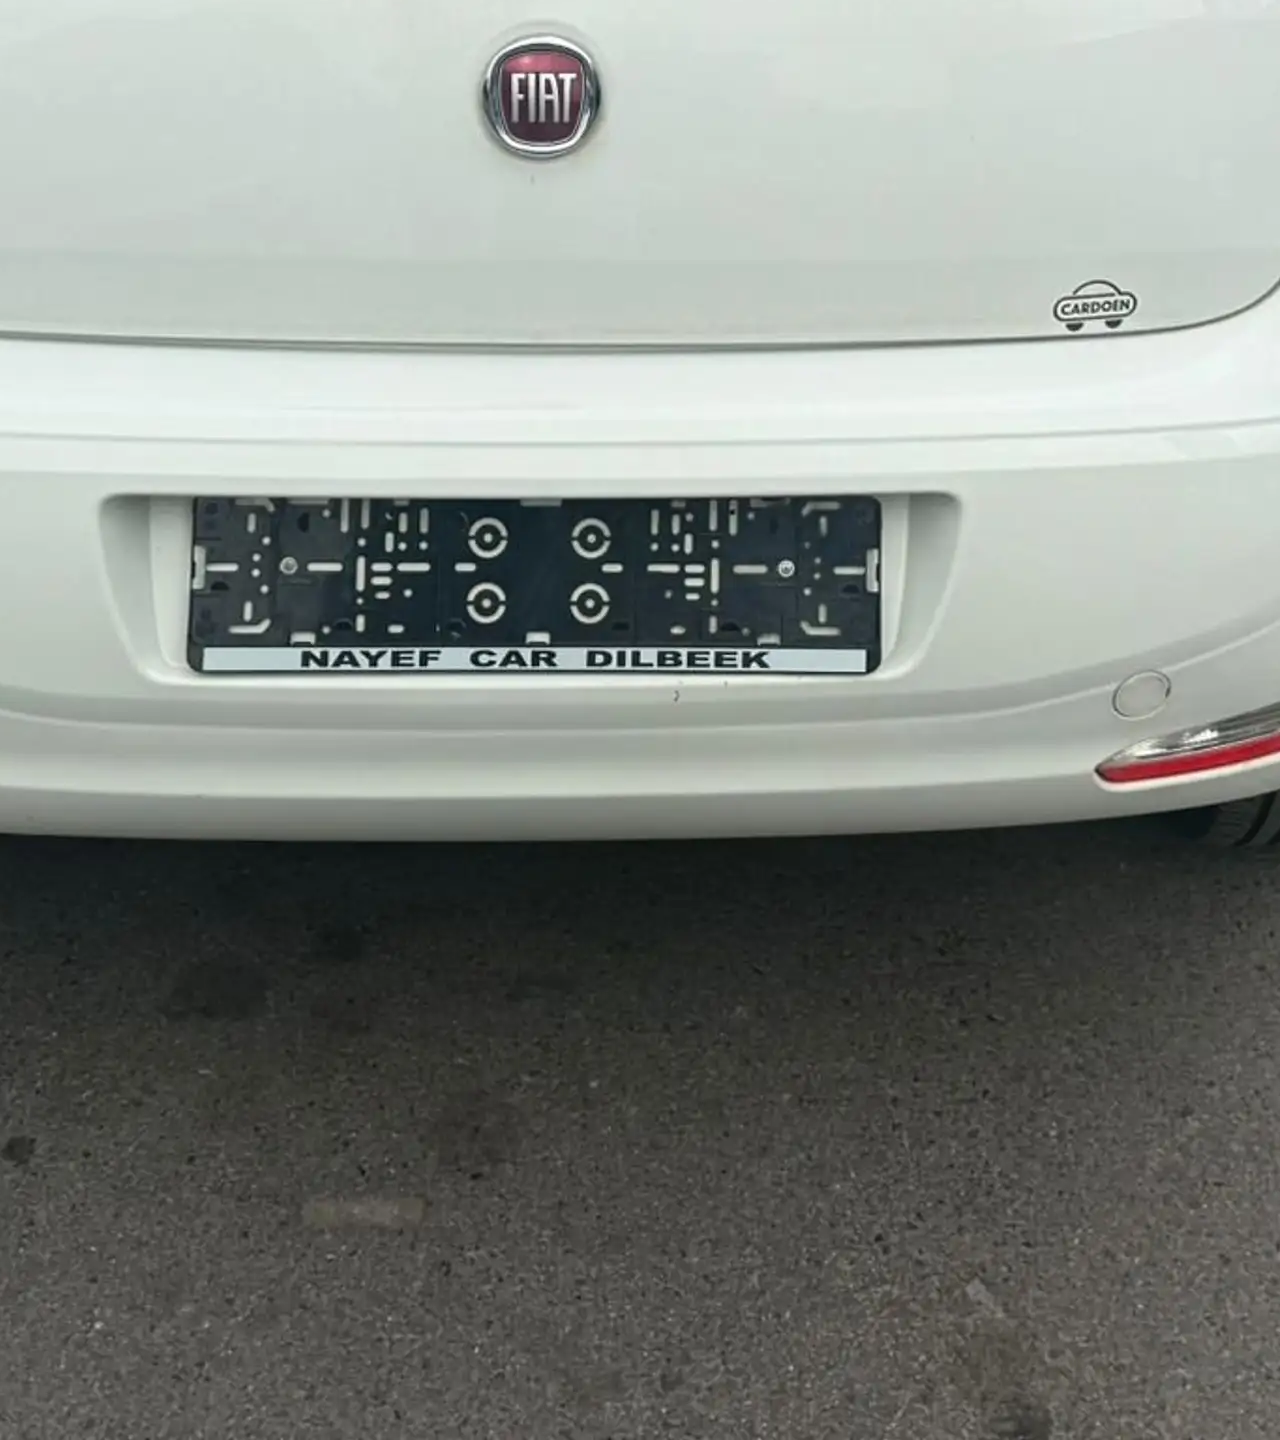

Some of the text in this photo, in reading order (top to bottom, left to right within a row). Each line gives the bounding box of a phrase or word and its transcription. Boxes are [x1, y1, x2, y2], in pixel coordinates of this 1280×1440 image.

[510, 72, 577, 123] FIAT
[300, 650, 770, 668] NAYEF CAR DILBEEK
